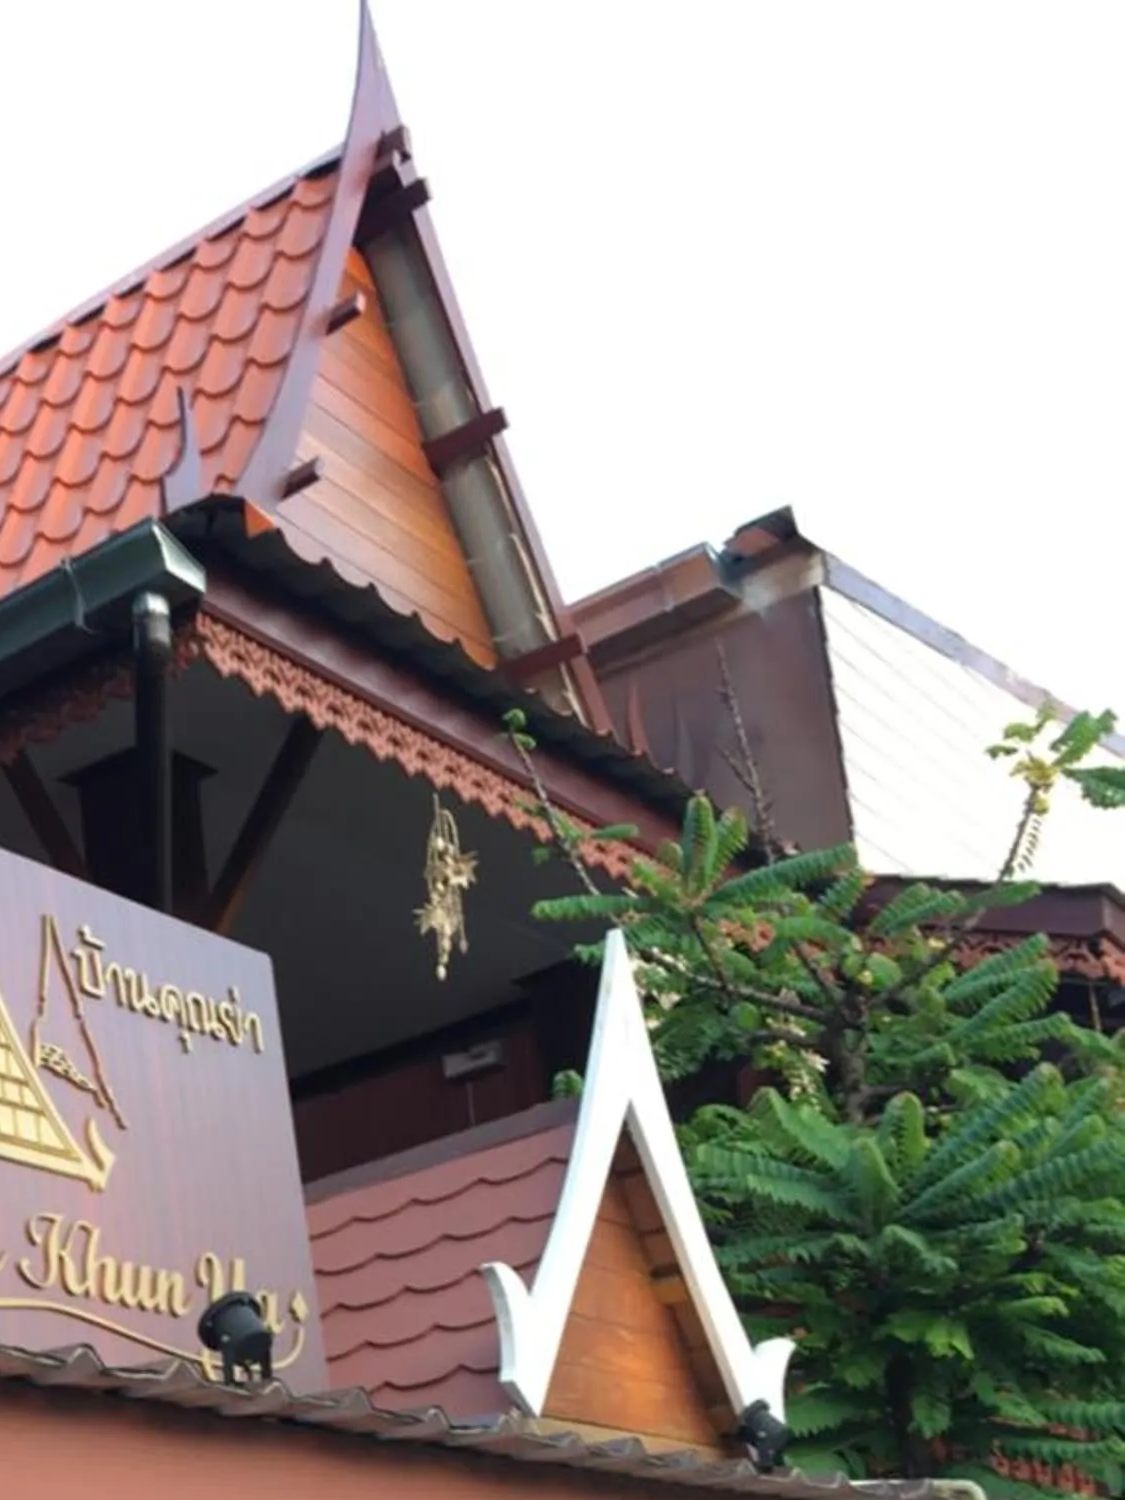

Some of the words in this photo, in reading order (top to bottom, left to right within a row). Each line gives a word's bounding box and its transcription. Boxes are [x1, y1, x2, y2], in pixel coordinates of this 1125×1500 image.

[72, 924, 265, 1054] บ้านคุณย่า
[18, 1211, 192, 1318] Khun
